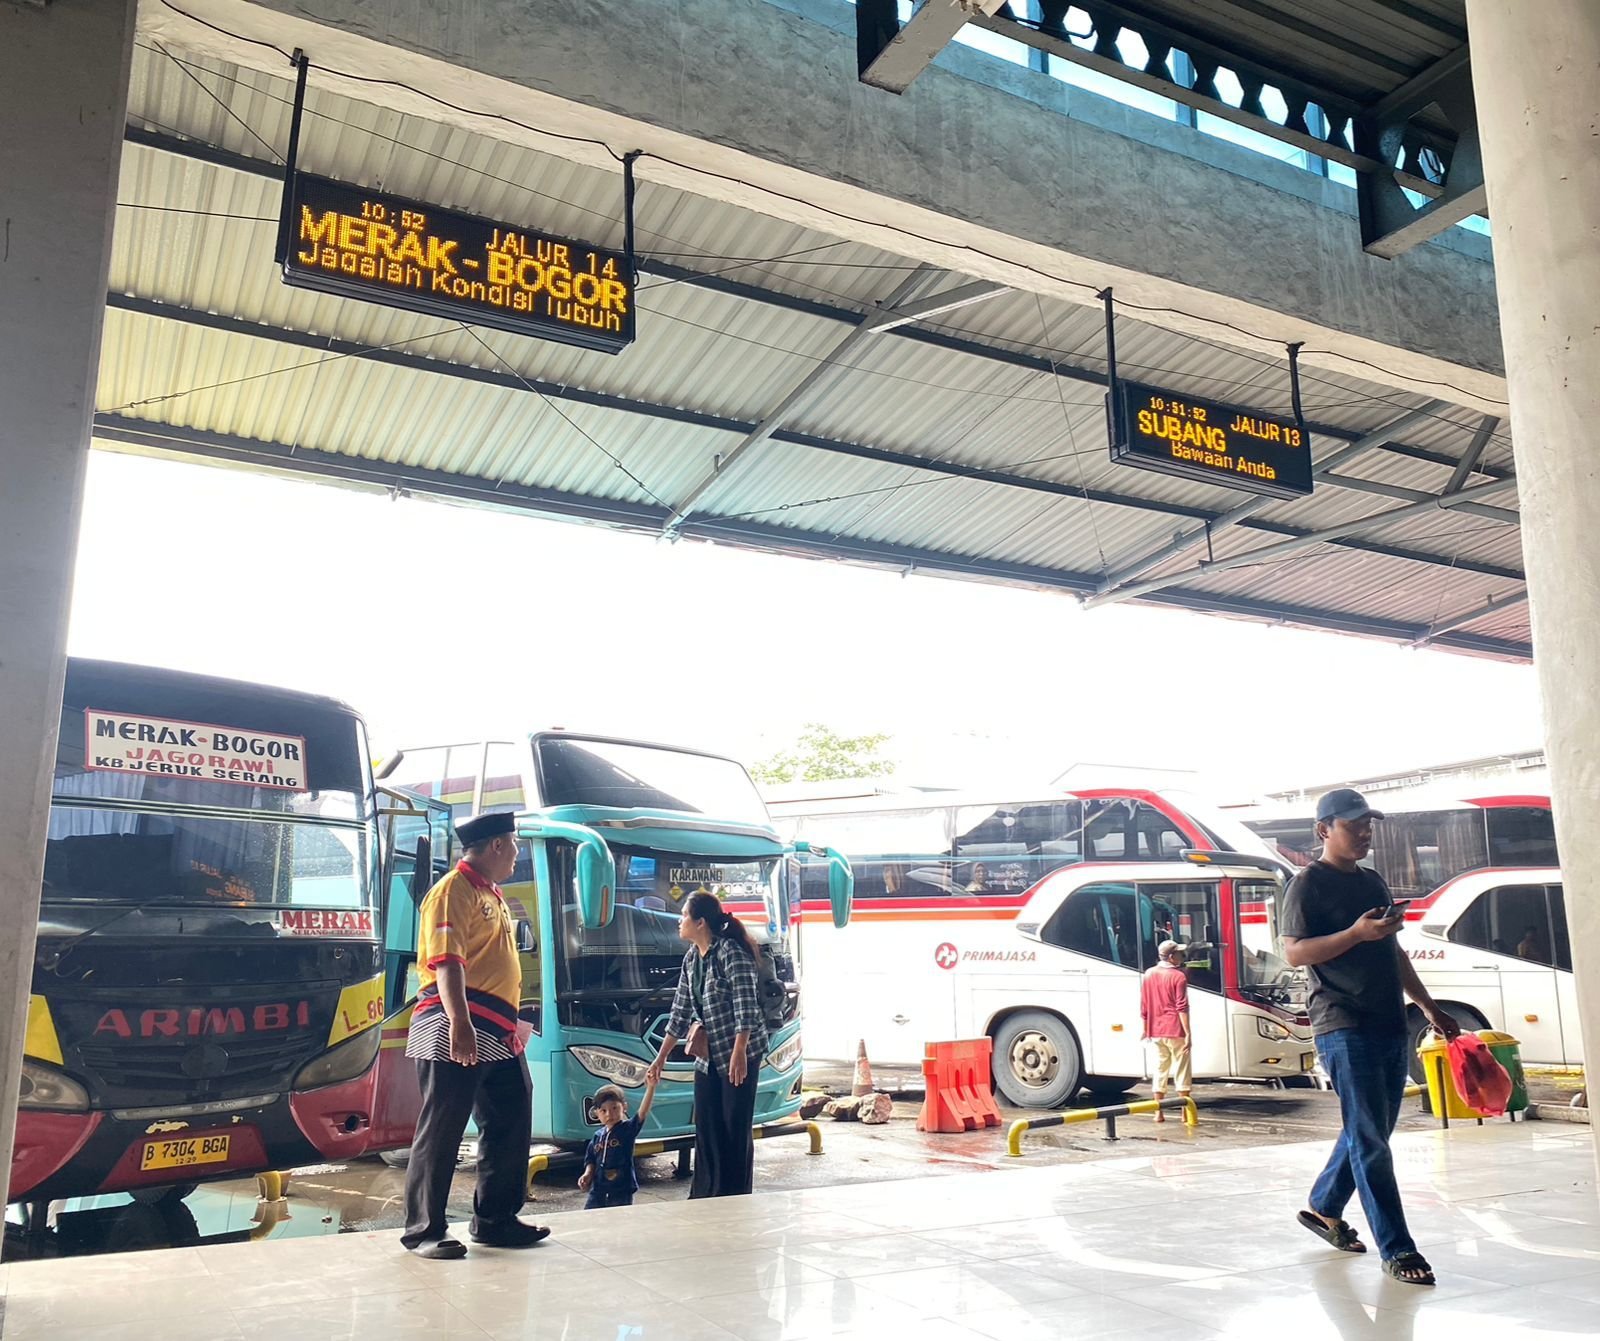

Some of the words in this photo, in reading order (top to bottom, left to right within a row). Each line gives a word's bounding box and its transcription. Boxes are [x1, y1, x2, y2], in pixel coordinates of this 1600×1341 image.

[300, 204, 458, 275] MERAK
[487, 249, 627, 313] BOGOR
[485, 228, 570, 267] JALUR
[586, 252, 618, 279] 14
[1150, 396, 1207, 421] 10:51:52
[1137, 409, 1226, 452] SUBANG
[1230, 414, 1280, 442] JALUR
[1282, 427, 1302, 447] 13
[1171, 440, 1233, 469] Bawaan
[1236, 456, 1276, 480] Anda
[213, 769, 298, 788] SERANG
[671, 868, 723, 882] KARAWANG
[281, 910, 373, 931] MERAK
[962, 951, 1037, 962] PRIMAJASA
[92, 1000, 311, 1039] ARIMBI
[145, 1146, 155, 1161] B
[161, 1140, 197, 1158] 7304
[202, 1136, 228, 1154] BGA
